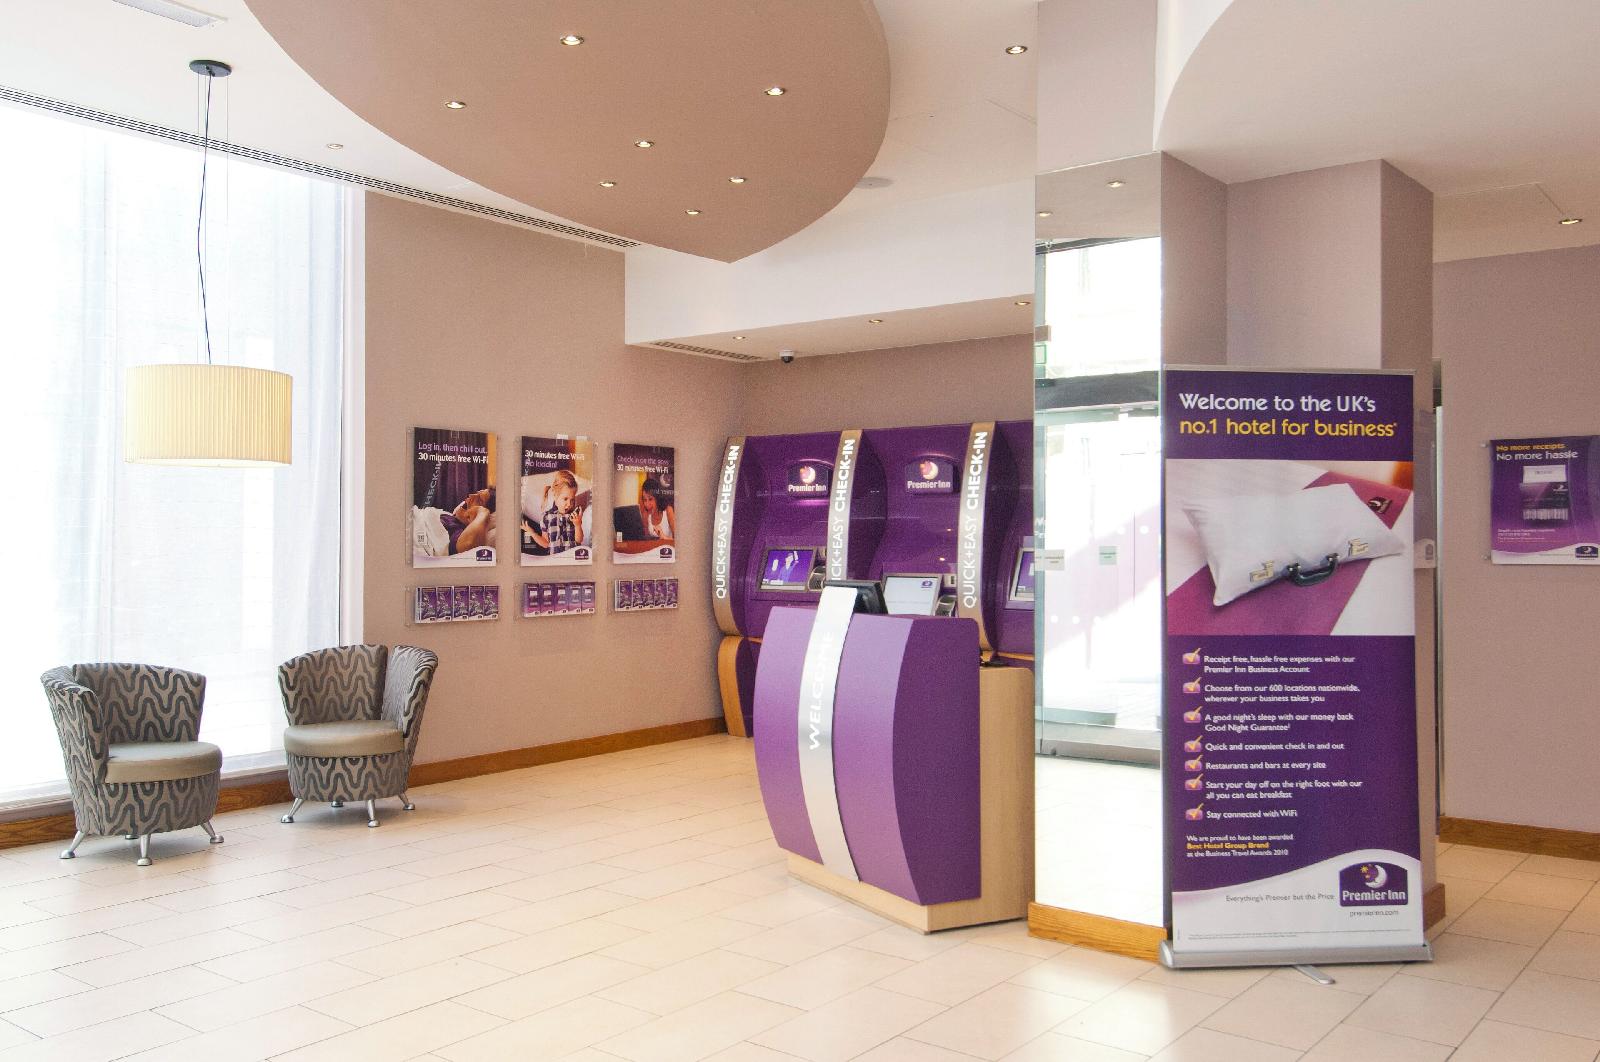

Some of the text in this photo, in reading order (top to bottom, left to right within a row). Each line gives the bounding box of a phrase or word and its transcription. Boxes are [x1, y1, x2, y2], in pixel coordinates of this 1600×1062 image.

[1179, 393, 1268, 411] Welcome
[1273, 396, 1295, 411] to
[1300, 395, 1332, 411] the
[1180, 418, 1217, 434] no.1
[1226, 418, 1276, 434] hotel
[1282, 418, 1310, 435] for
[418, 442, 432, 451] Log
[460, 445, 473, 453] chill
[418, 452, 489, 464] 30 minutes free Wi-Fi
[534, 451, 557, 459] minutes
[558, 452, 570, 460] free
[1546, 450, 1578, 459] hassle
[788, 484, 827, 492] Premier Inn
[907, 480, 951, 489] Premier Inn
[831, 439, 856, 581] ICK+EASY CHECK-IN
[716, 445, 740, 599] QUICK+EASY CHECK-IN
[963, 431, 988, 609] QUICK+EASY CHECK-IN
[1204, 655, 1232, 664] Receipt
[1289, 656, 1323, 664] expenses
[1213, 714, 1231, 723] good
[1258, 713, 1276, 722] sleep
[1310, 714, 1335, 722] money
[1227, 724, 1249, 733] Night
[1205, 743, 1228, 751] Quick
[1244, 742, 1284, 750] convenient
[1284, 742, 1306, 750] check
[1307, 742, 1315, 750] in
[1316, 742, 1330, 750] and
[1291, 762, 1311, 770] every
[1225, 782, 1243, 790] your
[1244, 781, 1258, 790] day
[1259, 780, 1270, 788] off
[1295, 780, 1313, 789] right
[1314, 779, 1330, 787] foot
[1331, 779, 1348, 787] with
[1206, 791, 1215, 799] all
[1259, 790, 1293, 798] breakfast
[1206, 809, 1298, 820] Stay connected with WiFi
[1209, 834, 1228, 842] proud
[1342, 889, 1406, 901] Premier Inn
